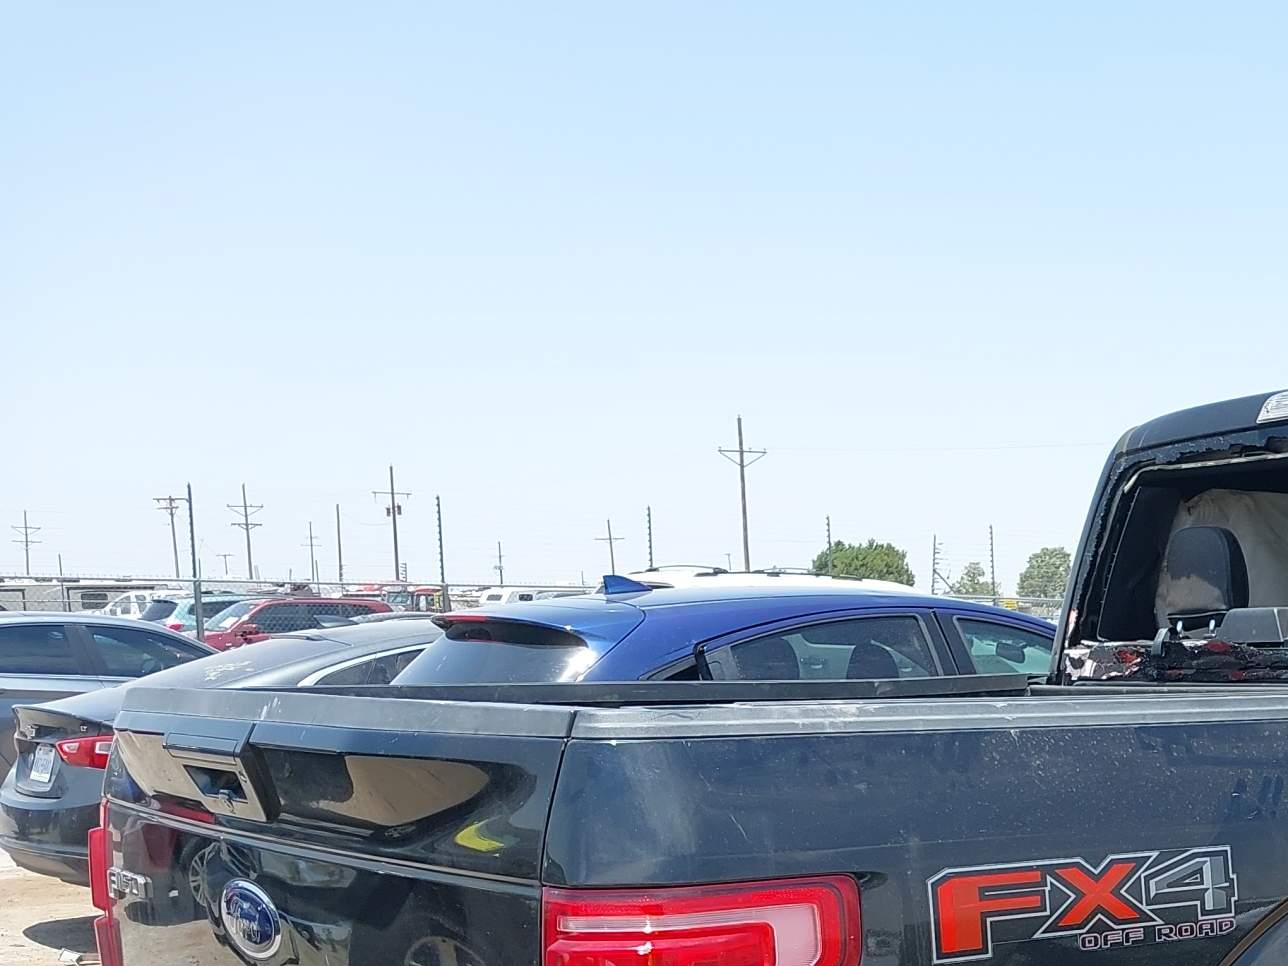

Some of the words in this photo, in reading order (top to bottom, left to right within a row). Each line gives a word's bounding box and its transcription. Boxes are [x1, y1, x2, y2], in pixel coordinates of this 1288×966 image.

[926, 845, 1238, 964] FX4
[1080, 930, 1144, 951] OFF
[1155, 918, 1237, 942] ROAD
